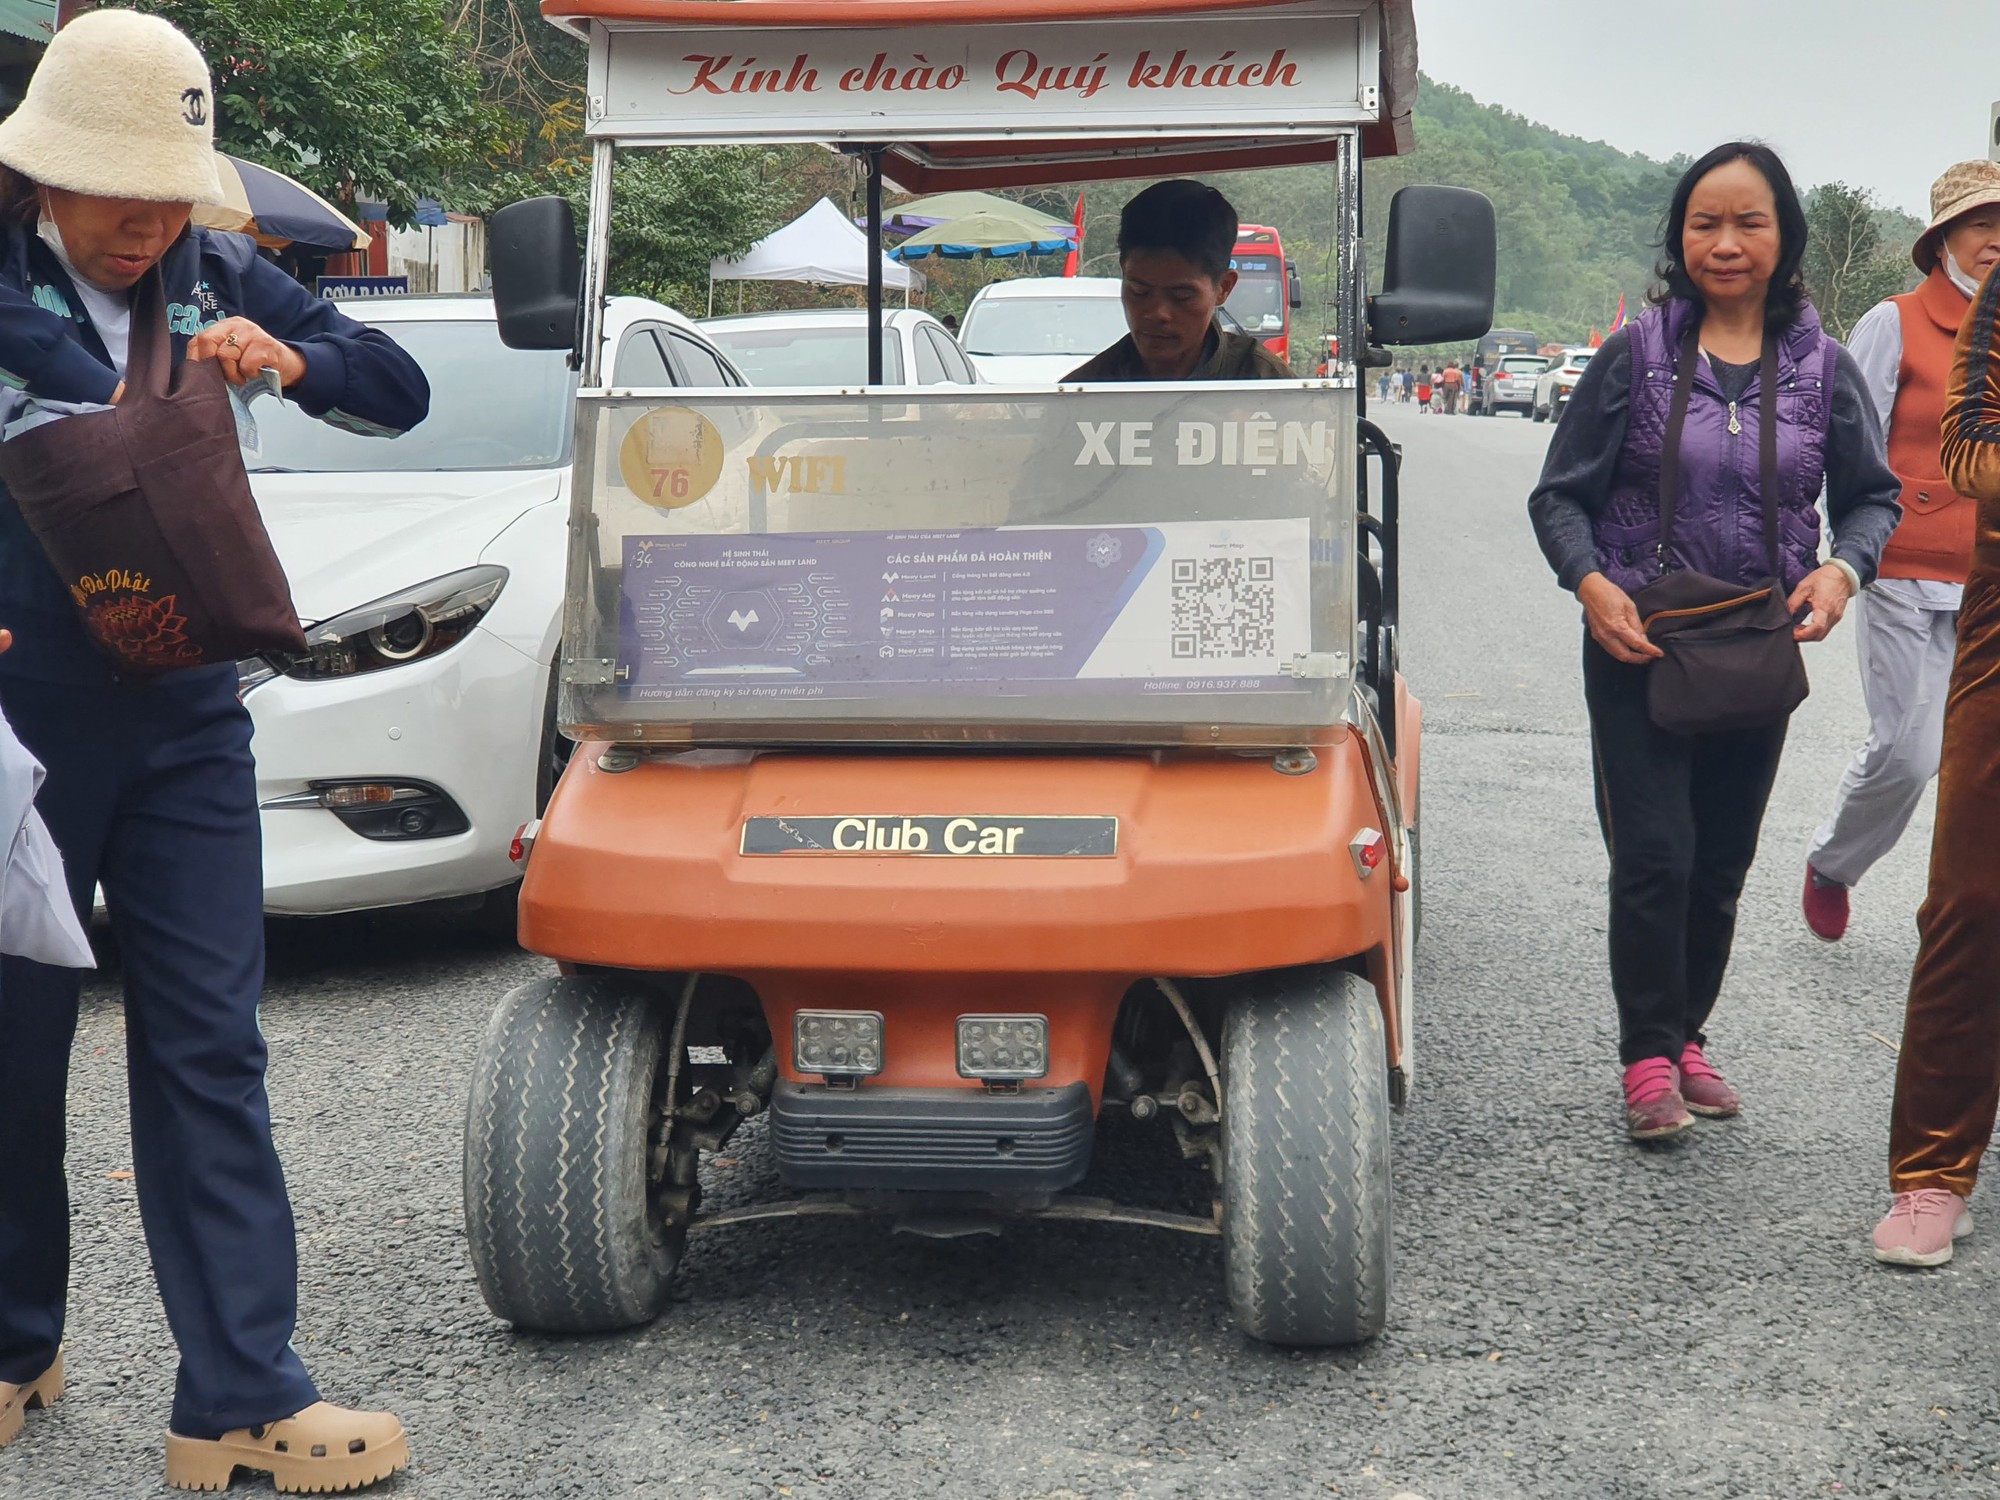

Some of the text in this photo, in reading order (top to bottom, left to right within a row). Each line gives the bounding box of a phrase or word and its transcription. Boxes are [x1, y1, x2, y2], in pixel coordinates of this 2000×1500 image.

[666, 49, 1302, 101] Kính chào Quý khách
[1073, 411, 1326, 476] XE ĐIỆN
[746, 455, 848, 494] WIFI
[650, 468, 689, 498] 76
[732, 550, 750, 558] SINH
[886, 549, 1052, 564] CÁC SẢN PHẨM ĐÃ HOÀN THIỆN
[674, 559, 697, 568] CÔNG
[699, 559, 719, 570] NGHỆ
[721, 557, 735, 568] BẤT
[778, 559, 796, 567] MEEY
[797, 558, 817, 566] LAND
[917, 611, 935, 619] Page
[1186, 679, 1261, 689] 0916.937.888
[639, 688, 673, 699] Hướng
[696, 687, 720, 699] đăng
[722, 686, 735, 698] ký
[753, 687, 777, 698] dụng
[832, 818, 1024, 854] Club Car
